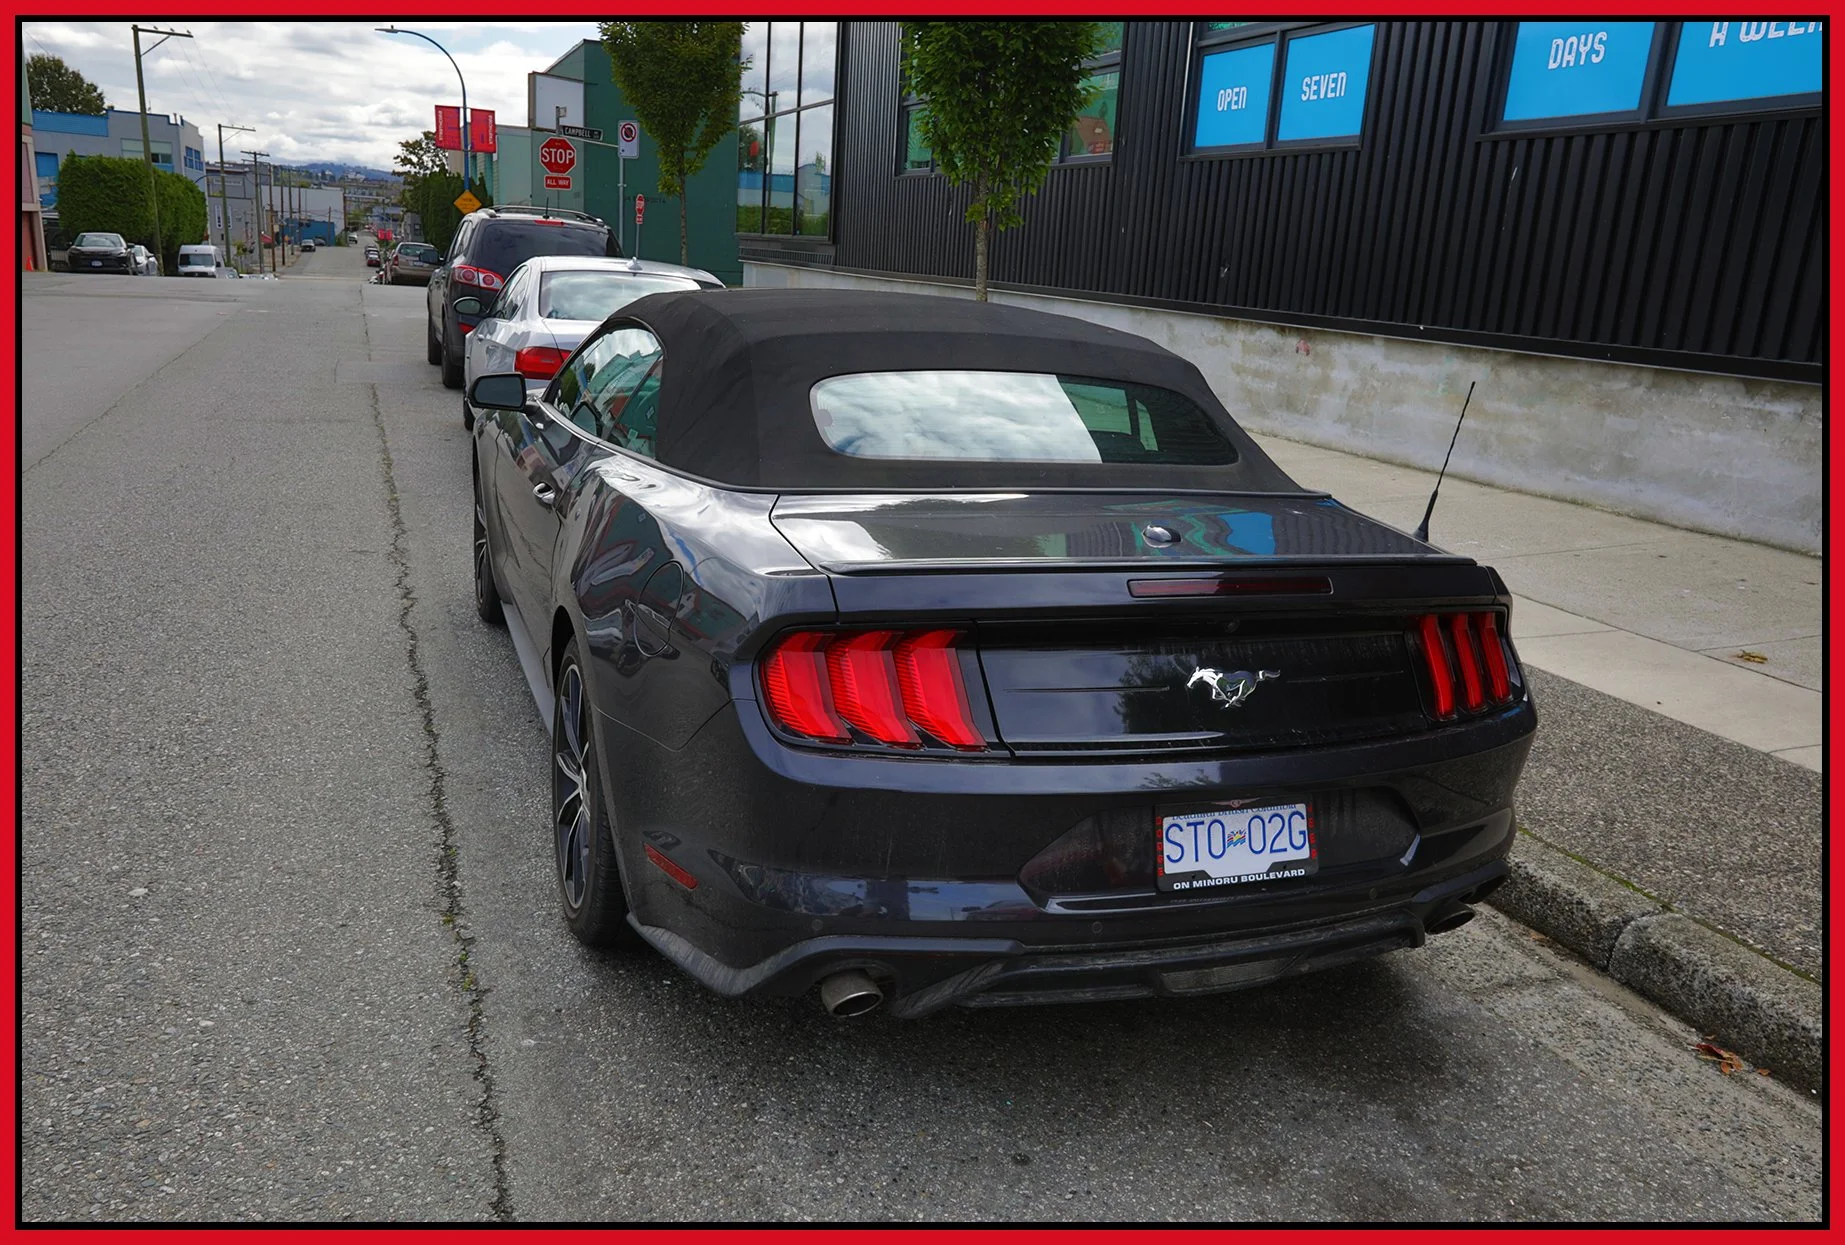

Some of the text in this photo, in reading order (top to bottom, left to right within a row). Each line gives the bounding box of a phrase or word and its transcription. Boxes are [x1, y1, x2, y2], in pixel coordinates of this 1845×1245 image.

[1217, 86, 1247, 112] OPEN
[1301, 71, 1347, 101] SEVEN
[1547, 31, 1608, 70] DAYS
[1709, 22, 1730, 48] A
[564, 127, 591, 138] CAMPBELL
[541, 148, 574, 164] STOP
[1173, 868, 1305, 890] ON MINORU BOULEVARD
